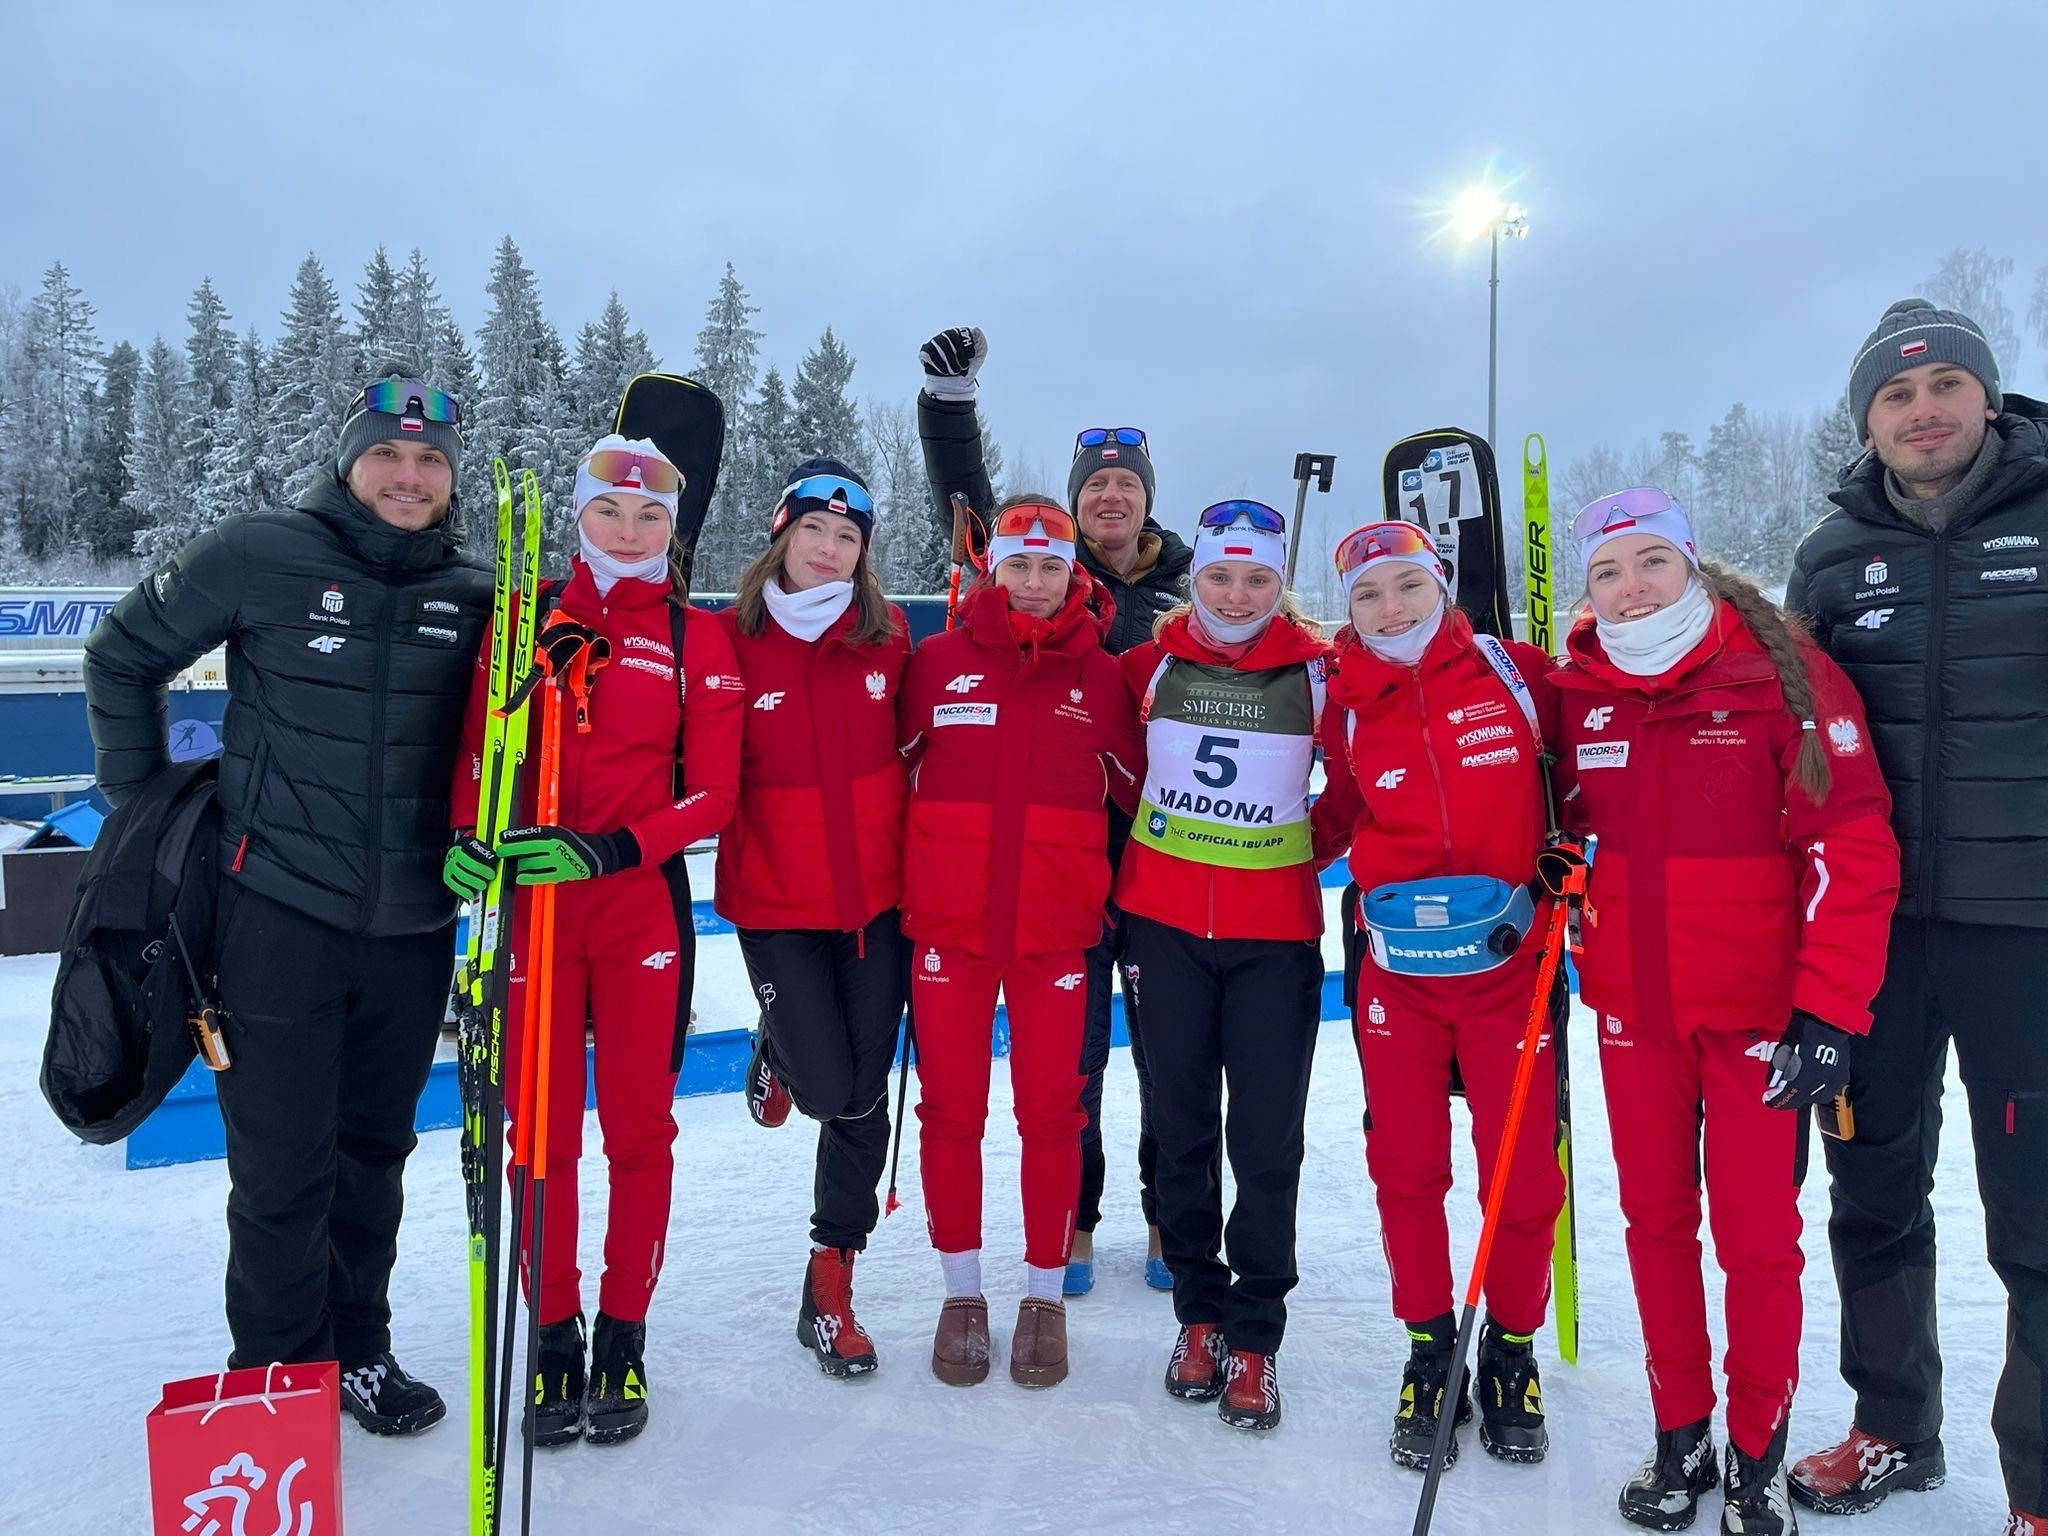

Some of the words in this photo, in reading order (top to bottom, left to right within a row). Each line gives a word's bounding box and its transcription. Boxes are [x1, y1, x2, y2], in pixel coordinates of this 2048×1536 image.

[1983, 536, 2040, 549] WYSOWIANKA
[1981, 567, 2037, 580] INCORSA
[1855, 590, 1875, 600] Bank
[1875, 586, 1899, 596] Polski
[423, 600, 459, 613] WYSOWIANKA
[309, 612, 329, 622] Bank
[329, 616, 351, 626] Polski
[491, 538, 507, 698] FISCHER
[1854, 608, 1895, 629] 4F
[417, 626, 458, 638] INCORSA
[307, 635, 346, 654] 4F
[620, 657, 674, 675] INCORSA
[1486, 639, 1526, 689] INCORSA
[945, 674, 985, 693] 4F
[753, 691, 786, 711] 4F
[936, 706, 992, 717] INCORSA
[1583, 706, 1614, 731] 4F
[1226, 719, 1260, 729] KROGS
[1698, 729, 1739, 737] Ministerstwo
[1456, 726, 1514, 746] WYSOWIANKA
[1690, 738, 1712, 746] Sportu
[1716, 738, 1747, 746] Turystyki
[1461, 746, 1519, 765] INCORSA
[1579, 745, 1625, 757] INCORSA
[1192, 735, 1240, 789] 5
[1375, 768, 1407, 790] 4F
[1159, 787, 1274, 824] MADONA
[503, 826, 542, 840] Roeckl
[1170, 826, 1186, 839] THE
[1188, 831, 1240, 847] OFFICIAL
[1242, 840, 1262, 849] IBU
[1263, 837, 1284, 848] APP
[469, 839, 496, 860] Roeckl
[556, 844, 589, 879] Roeckl
[642, 951, 677, 970] 4F
[1389, 944, 1479, 959] barnett
[1054, 973, 1085, 990] 4F
[490, 1007, 502, 1087] FISCHER
